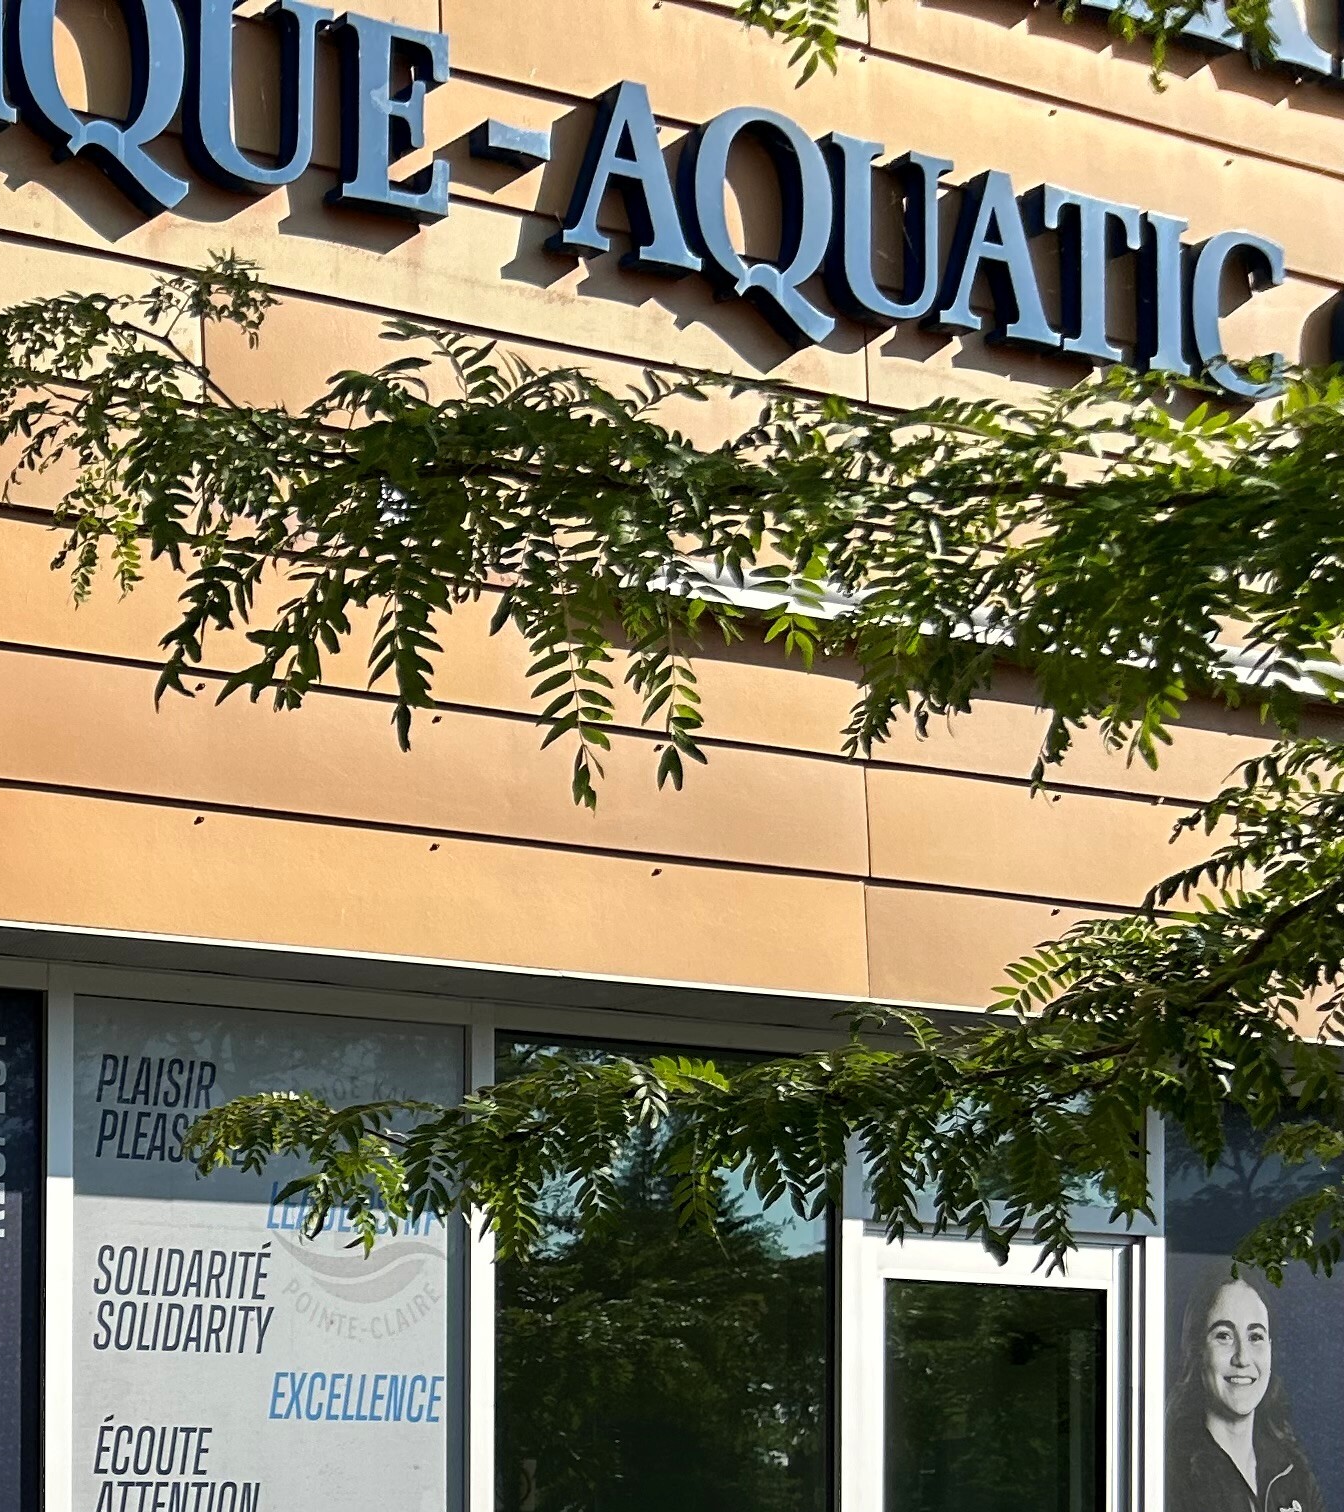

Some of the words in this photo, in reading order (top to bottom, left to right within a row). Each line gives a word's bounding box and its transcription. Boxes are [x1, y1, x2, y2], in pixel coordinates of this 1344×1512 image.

[96, 1054, 216, 1109] PLAISIR
[93, 1241, 272, 1300] SOLIDARITÉ
[93, 1300, 274, 1354] SOLIDARITY
[268, 1372, 444, 1422] EXCELLENCE
[94, 1414, 212, 1476] ÉCOUTE
